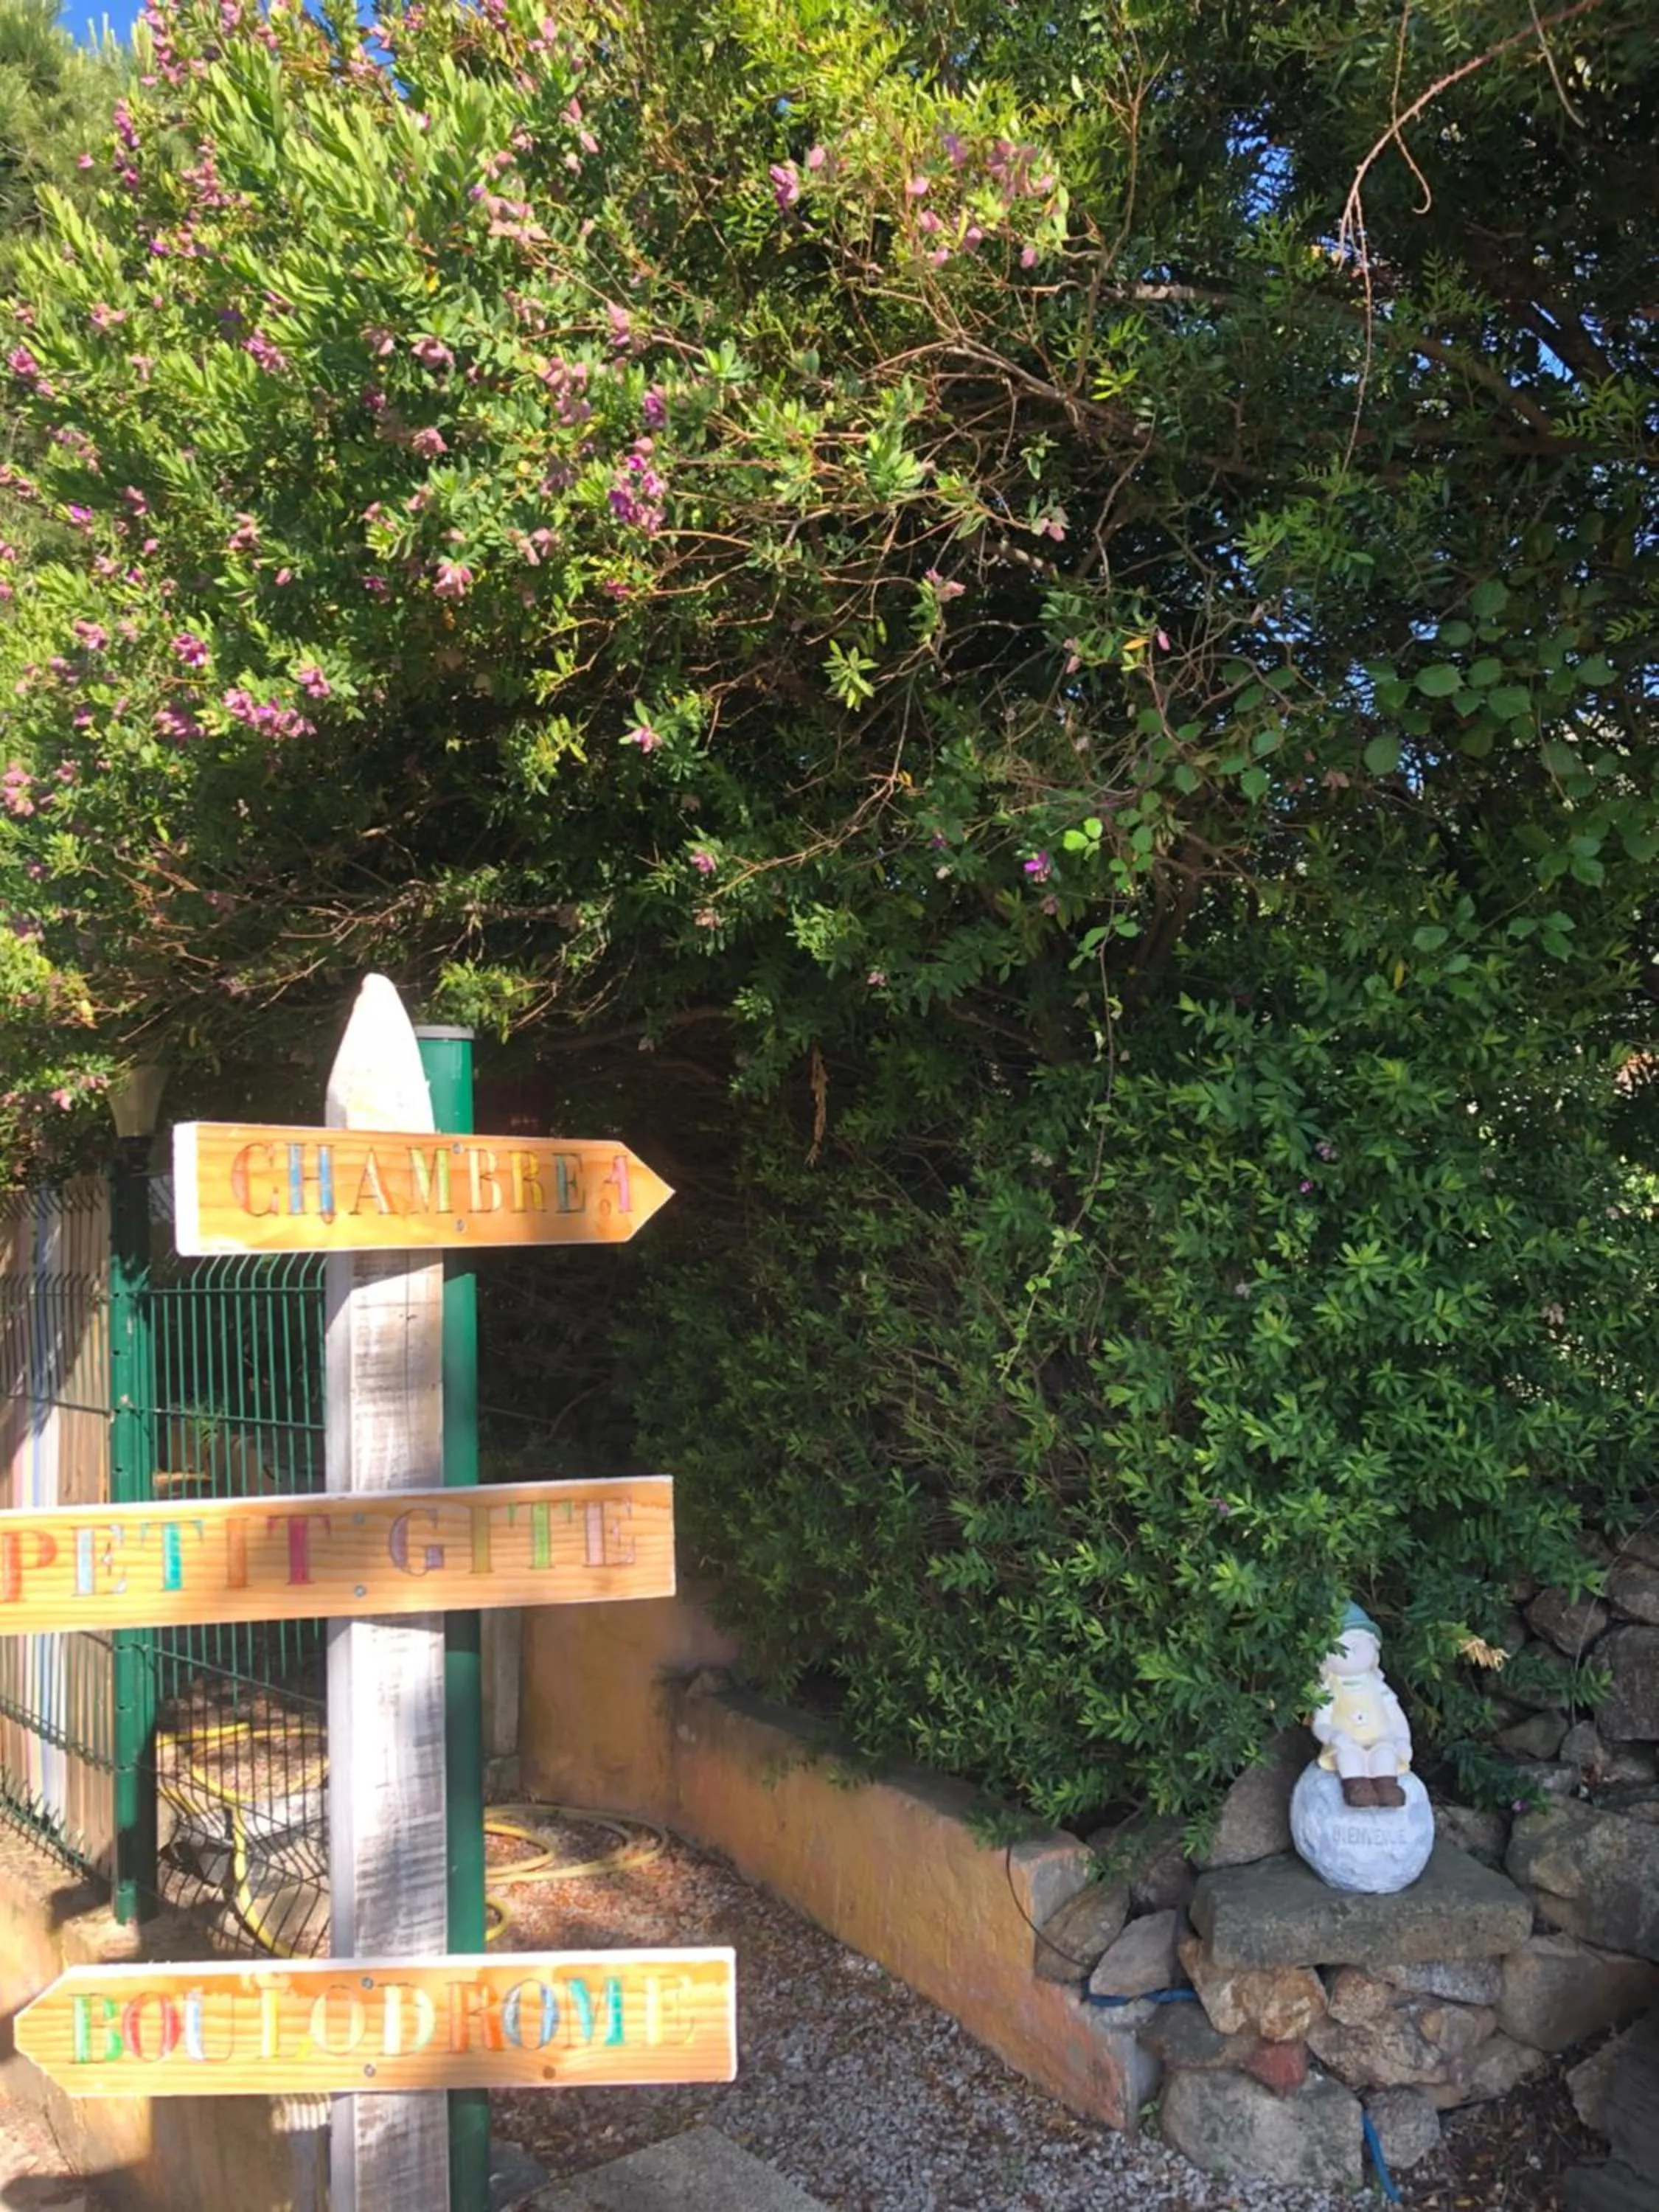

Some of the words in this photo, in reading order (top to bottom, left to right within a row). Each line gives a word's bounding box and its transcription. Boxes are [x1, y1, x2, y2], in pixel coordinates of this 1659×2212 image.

[230, 1141, 587, 1219] CHAMBRE
[0, 1513, 333, 1605] PETIT
[388, 1494, 636, 1577] GITE
[68, 1974, 695, 2064] BOULODROME
